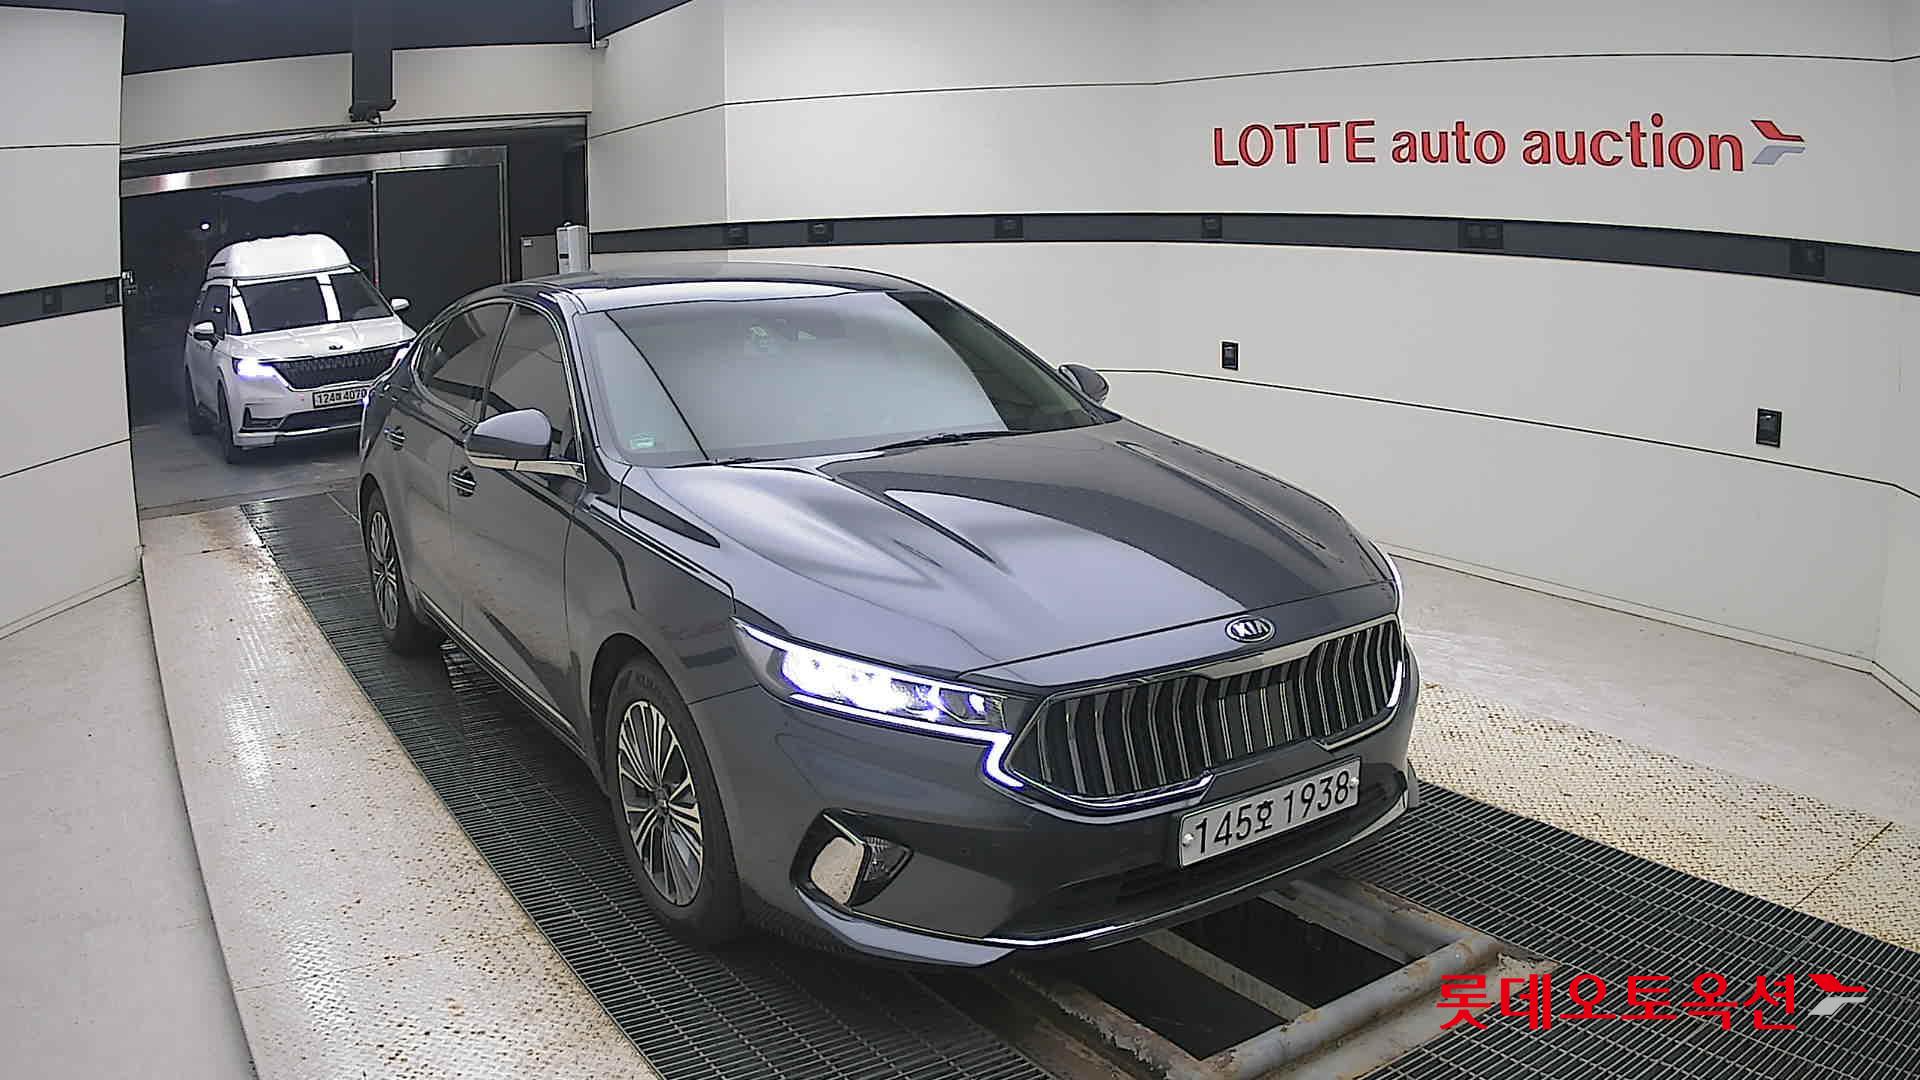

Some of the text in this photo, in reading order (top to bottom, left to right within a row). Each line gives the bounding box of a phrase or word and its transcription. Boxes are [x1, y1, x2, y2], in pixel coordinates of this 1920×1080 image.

[1213, 112, 1744, 171] LOTTE auto auction
[1231, 620, 1269, 637] KIA
[1195, 770, 1350, 854] 145호 1938
